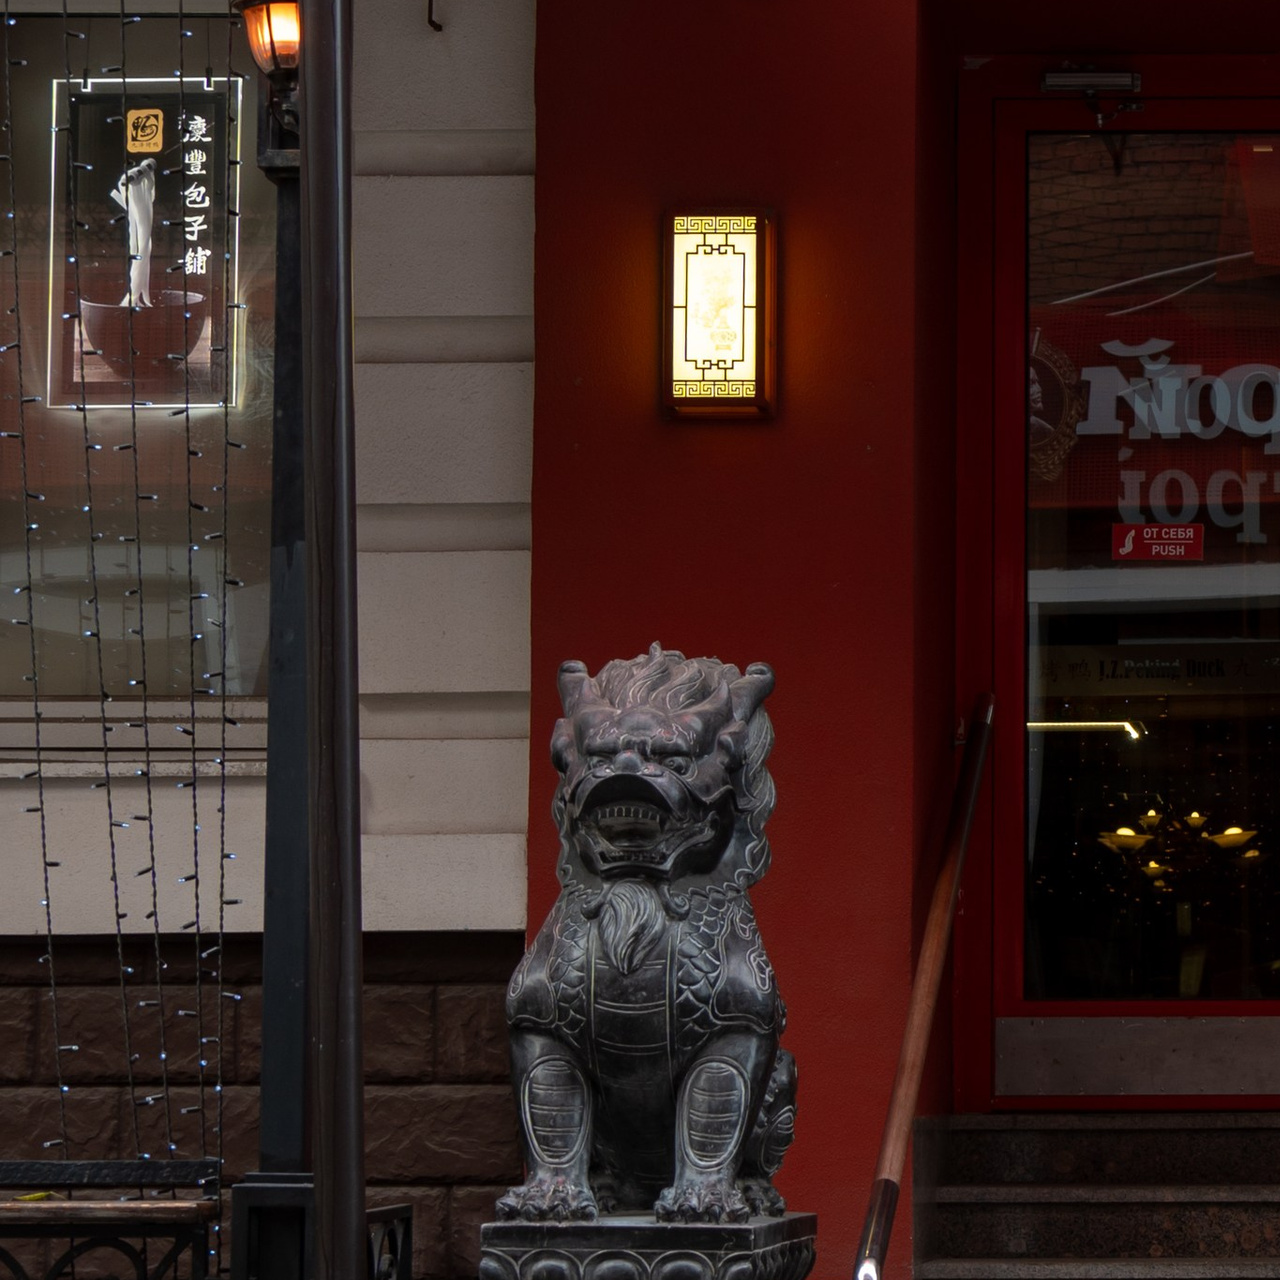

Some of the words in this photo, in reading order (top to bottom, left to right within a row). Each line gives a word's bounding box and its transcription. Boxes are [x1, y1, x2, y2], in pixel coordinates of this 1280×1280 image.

[1143, 528, 1159, 539] ОТ
[1161, 528, 1194, 539] СЕБЯ
[1151, 545, 1185, 556] PUSH
